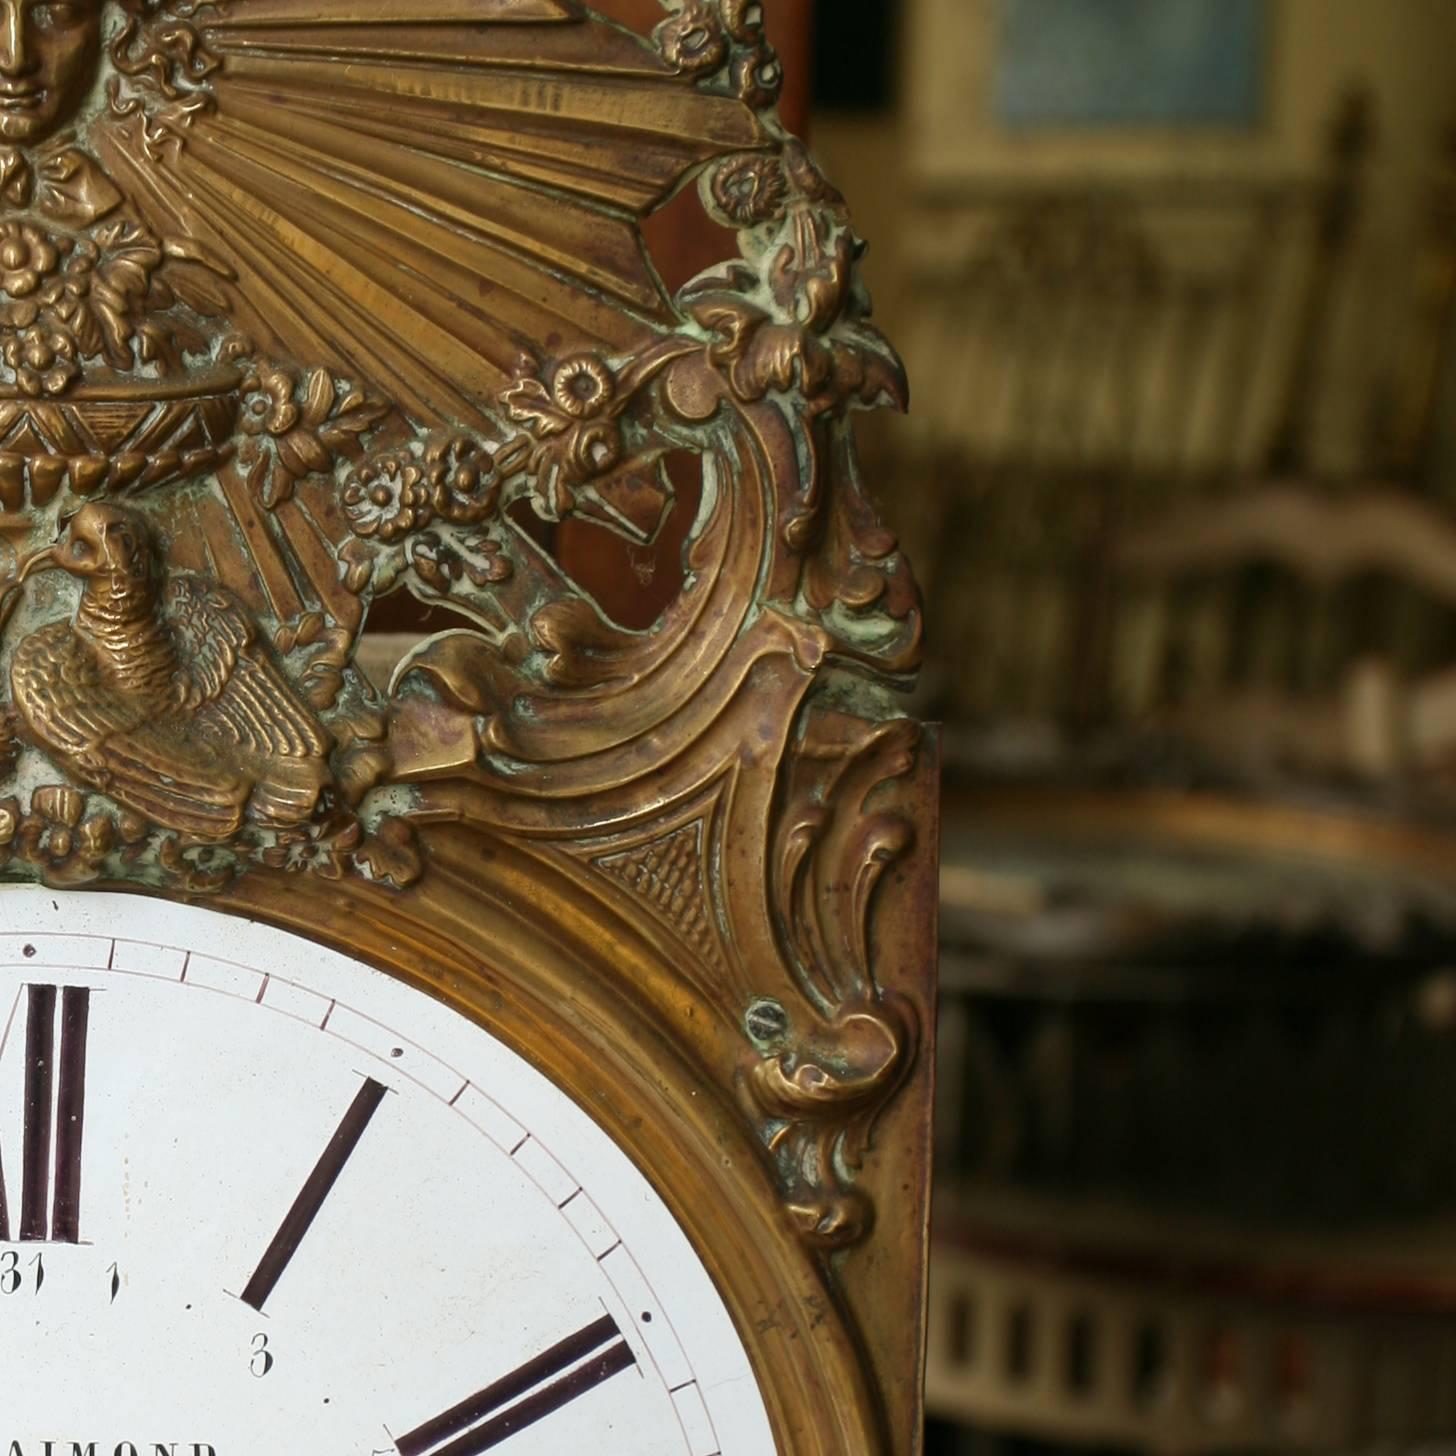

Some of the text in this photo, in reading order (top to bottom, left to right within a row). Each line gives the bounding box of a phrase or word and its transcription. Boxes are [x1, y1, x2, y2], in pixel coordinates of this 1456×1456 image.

[224, 1069, 400, 1318] I
[0, 1250, 45, 1296] 31
[248, 1332, 274, 1378] 3
